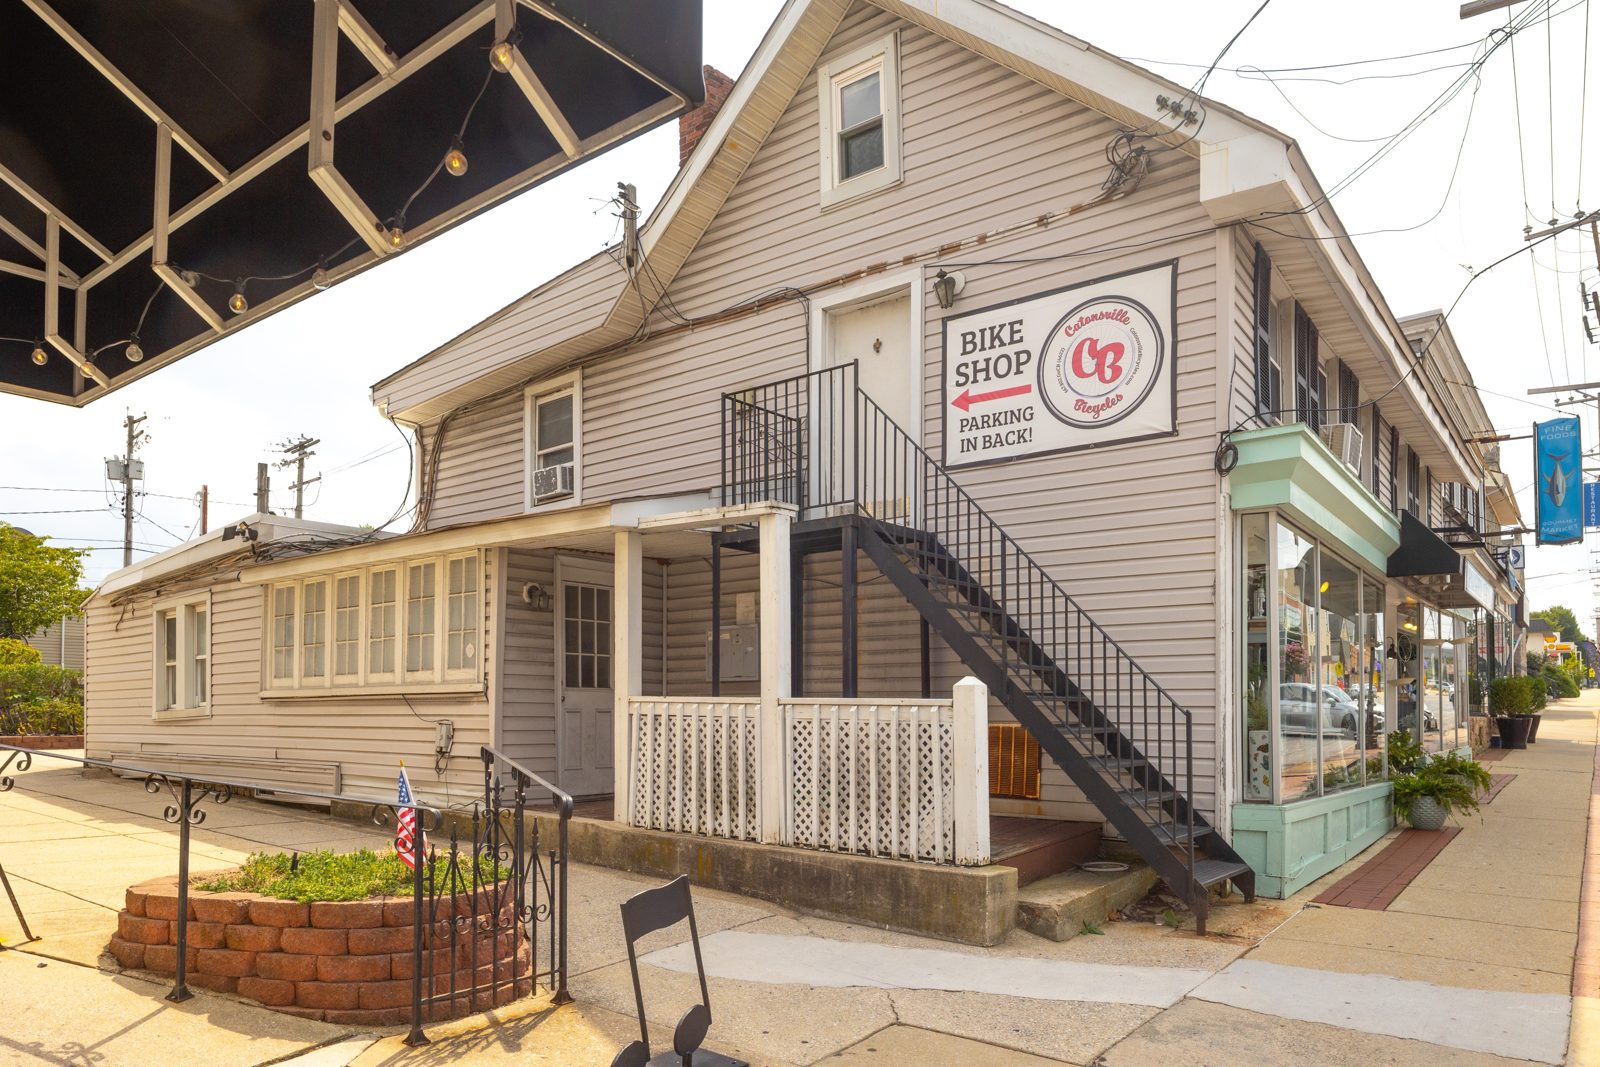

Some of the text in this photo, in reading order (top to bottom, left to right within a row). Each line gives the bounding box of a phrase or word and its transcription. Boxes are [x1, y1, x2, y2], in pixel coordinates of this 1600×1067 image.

[1064, 308, 1131, 338] Catonsville
[960, 319, 1024, 356] BIKE
[955, 349, 1032, 388] SHOP
[1071, 337, 1125, 385] CB
[1073, 392, 1124, 419] Bicycles
[959, 406, 1035, 433] PARKING
[1544, 424, 1573, 435] FINE
[960, 426, 1033, 453] IN BACK!
[1540, 432, 1577, 441] FOODS
[1541, 524, 1578, 534] MARKET
[1542, 518, 1577, 527] GOURMET
